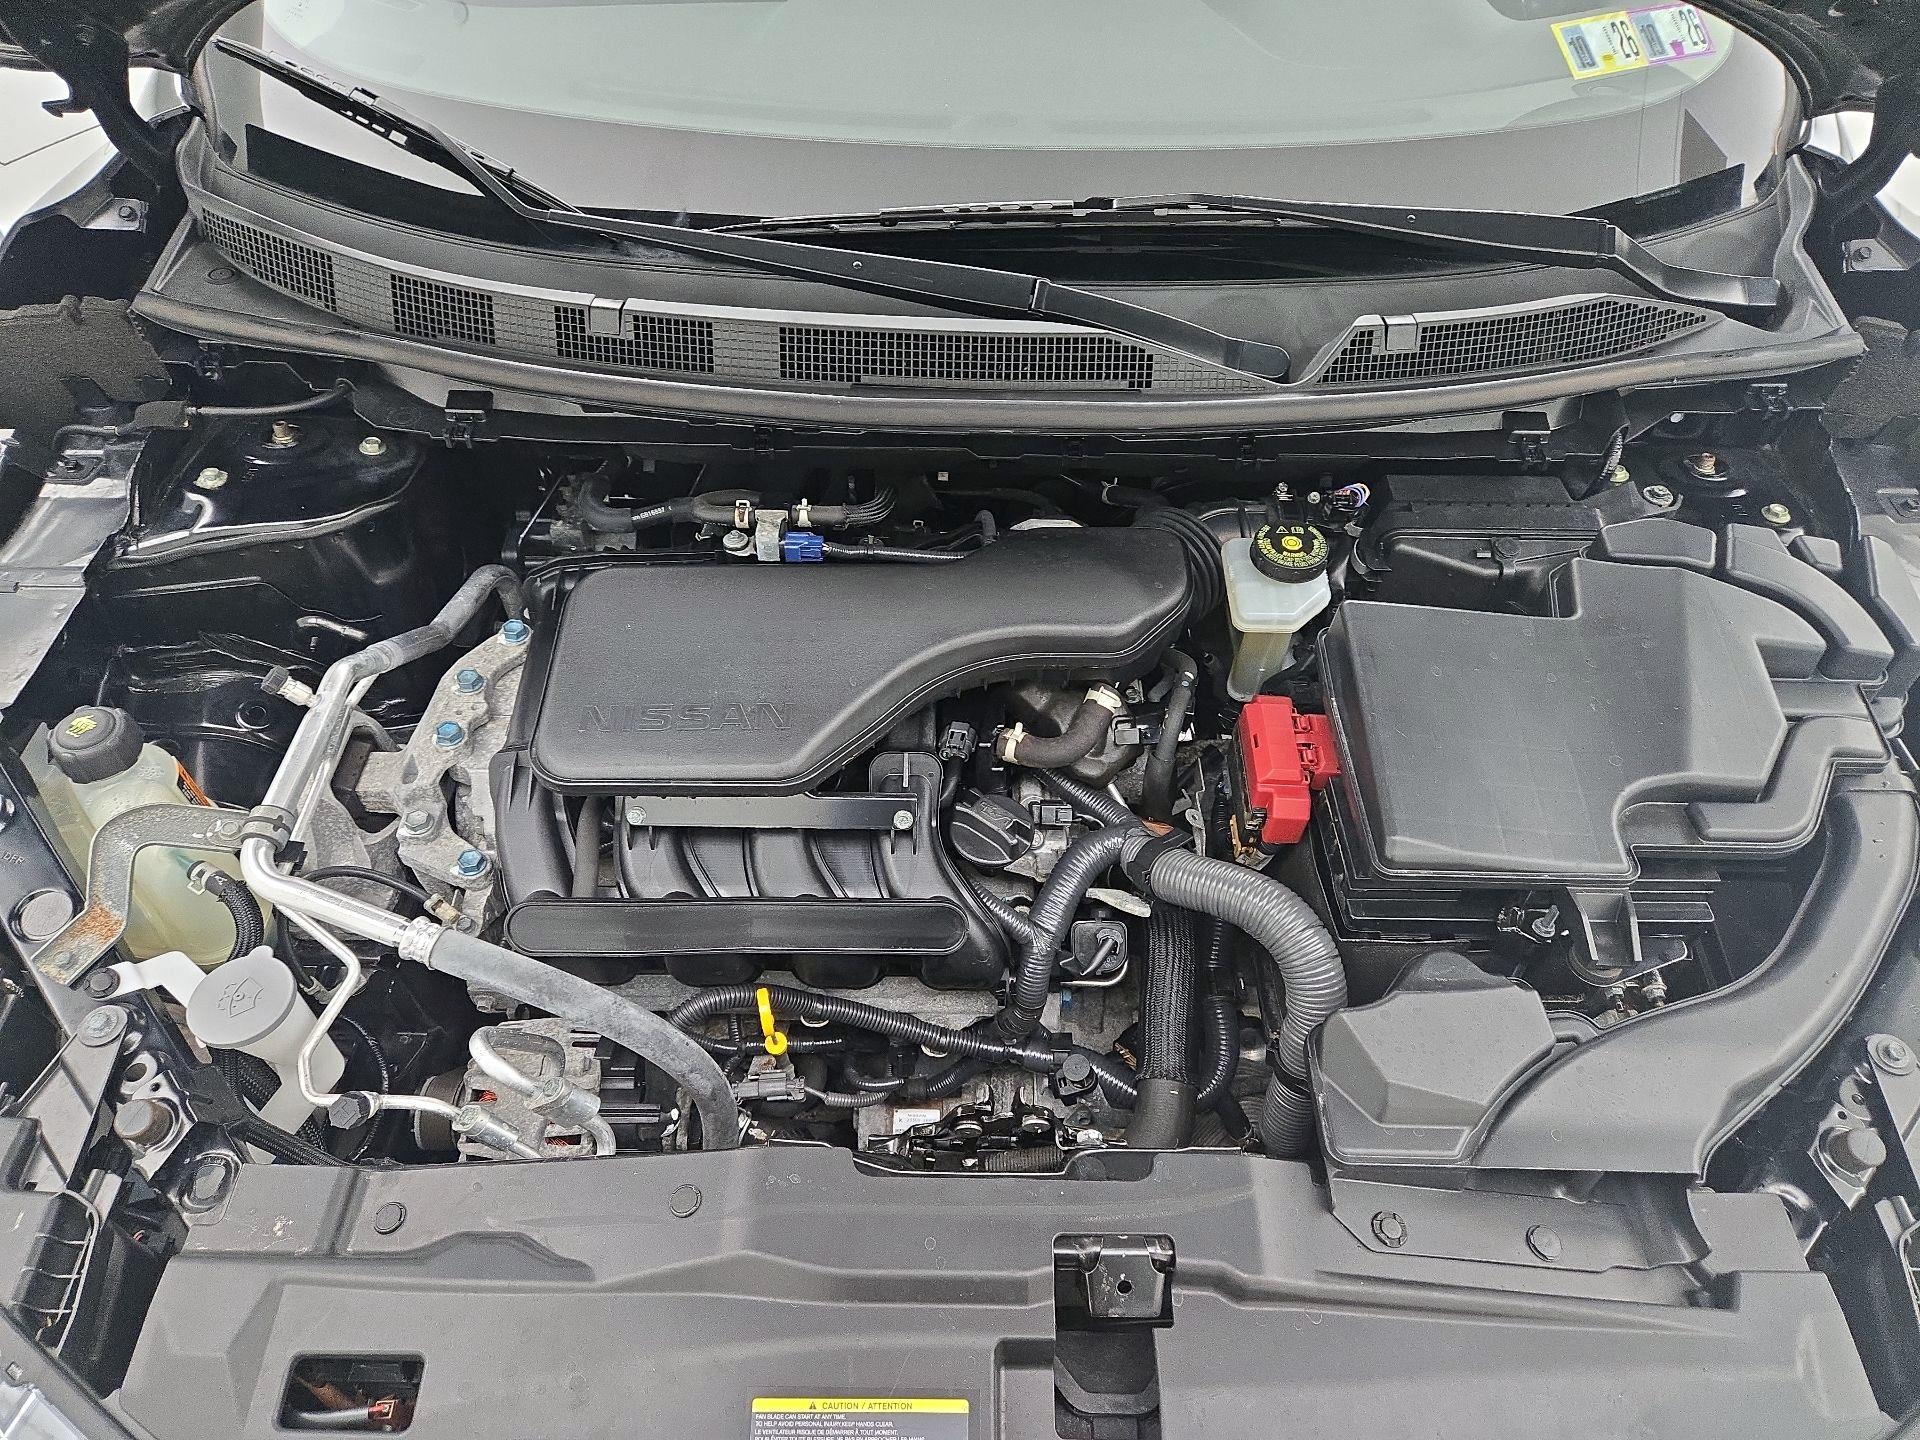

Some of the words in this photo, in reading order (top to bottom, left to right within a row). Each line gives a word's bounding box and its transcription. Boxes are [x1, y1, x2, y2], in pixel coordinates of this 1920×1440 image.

[1611, 20, 1640, 59] 26
[577, 702, 797, 732] NISSAN
[822, 1402, 859, 1410] CAUTION
[867, 1402, 913, 1411] ATTENTION
